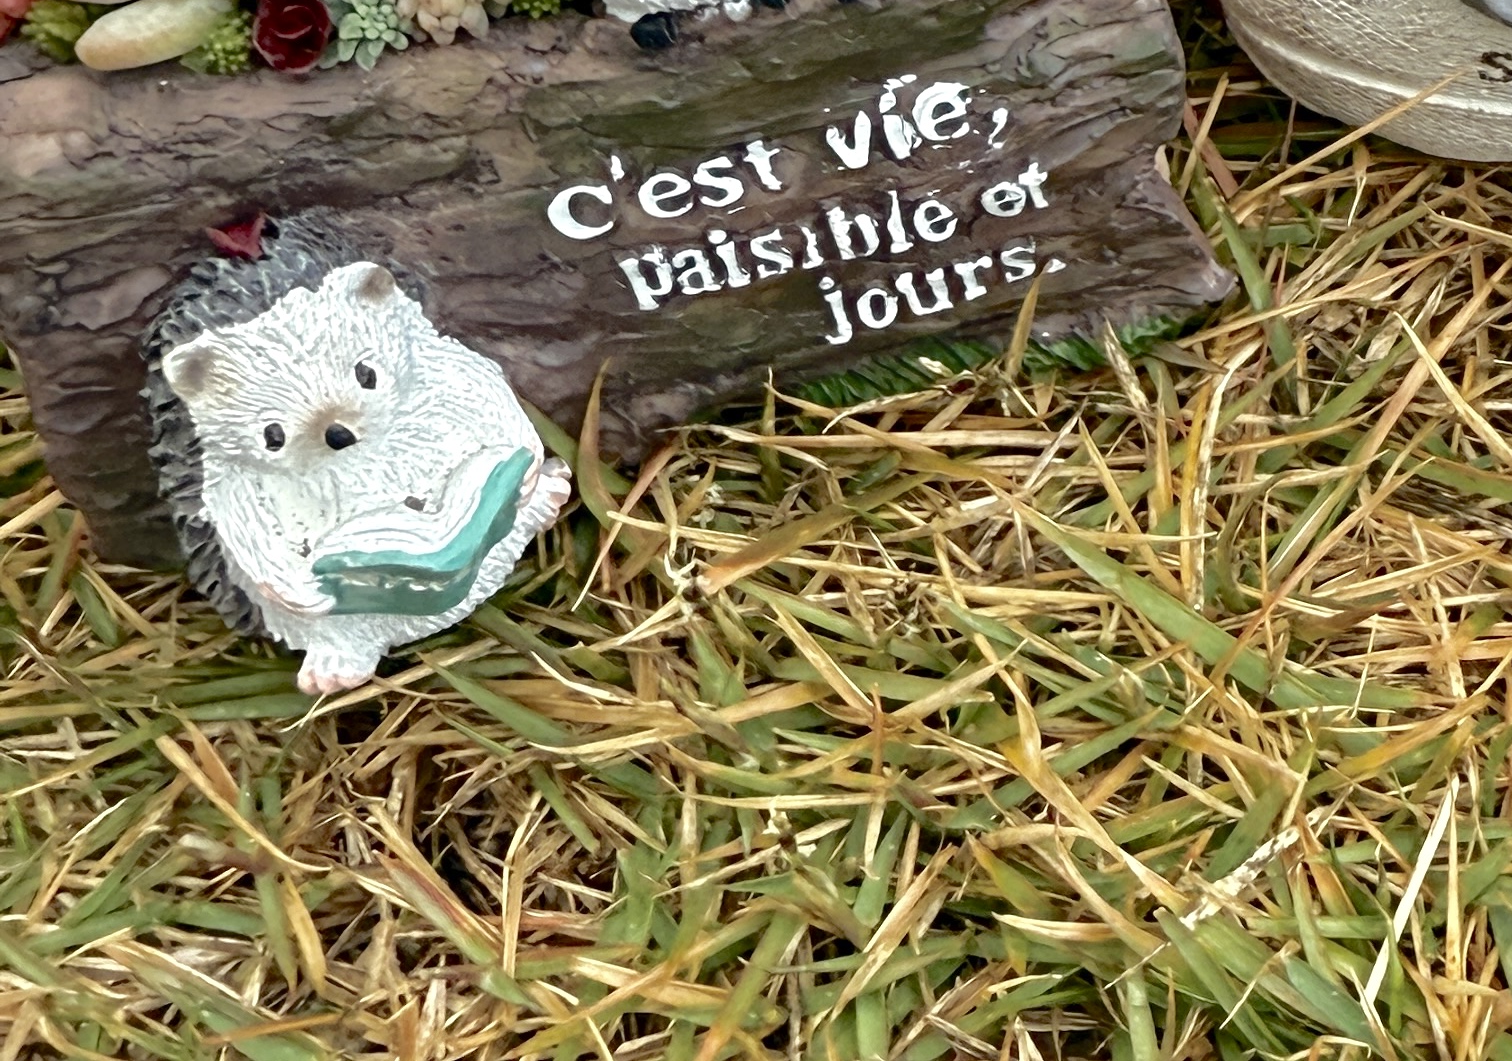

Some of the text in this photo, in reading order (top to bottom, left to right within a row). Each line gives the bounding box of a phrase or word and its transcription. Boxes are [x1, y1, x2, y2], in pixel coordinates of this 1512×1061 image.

[618, 161, 1049, 312] paisible et
[818, 241, 1068, 346] jours.
